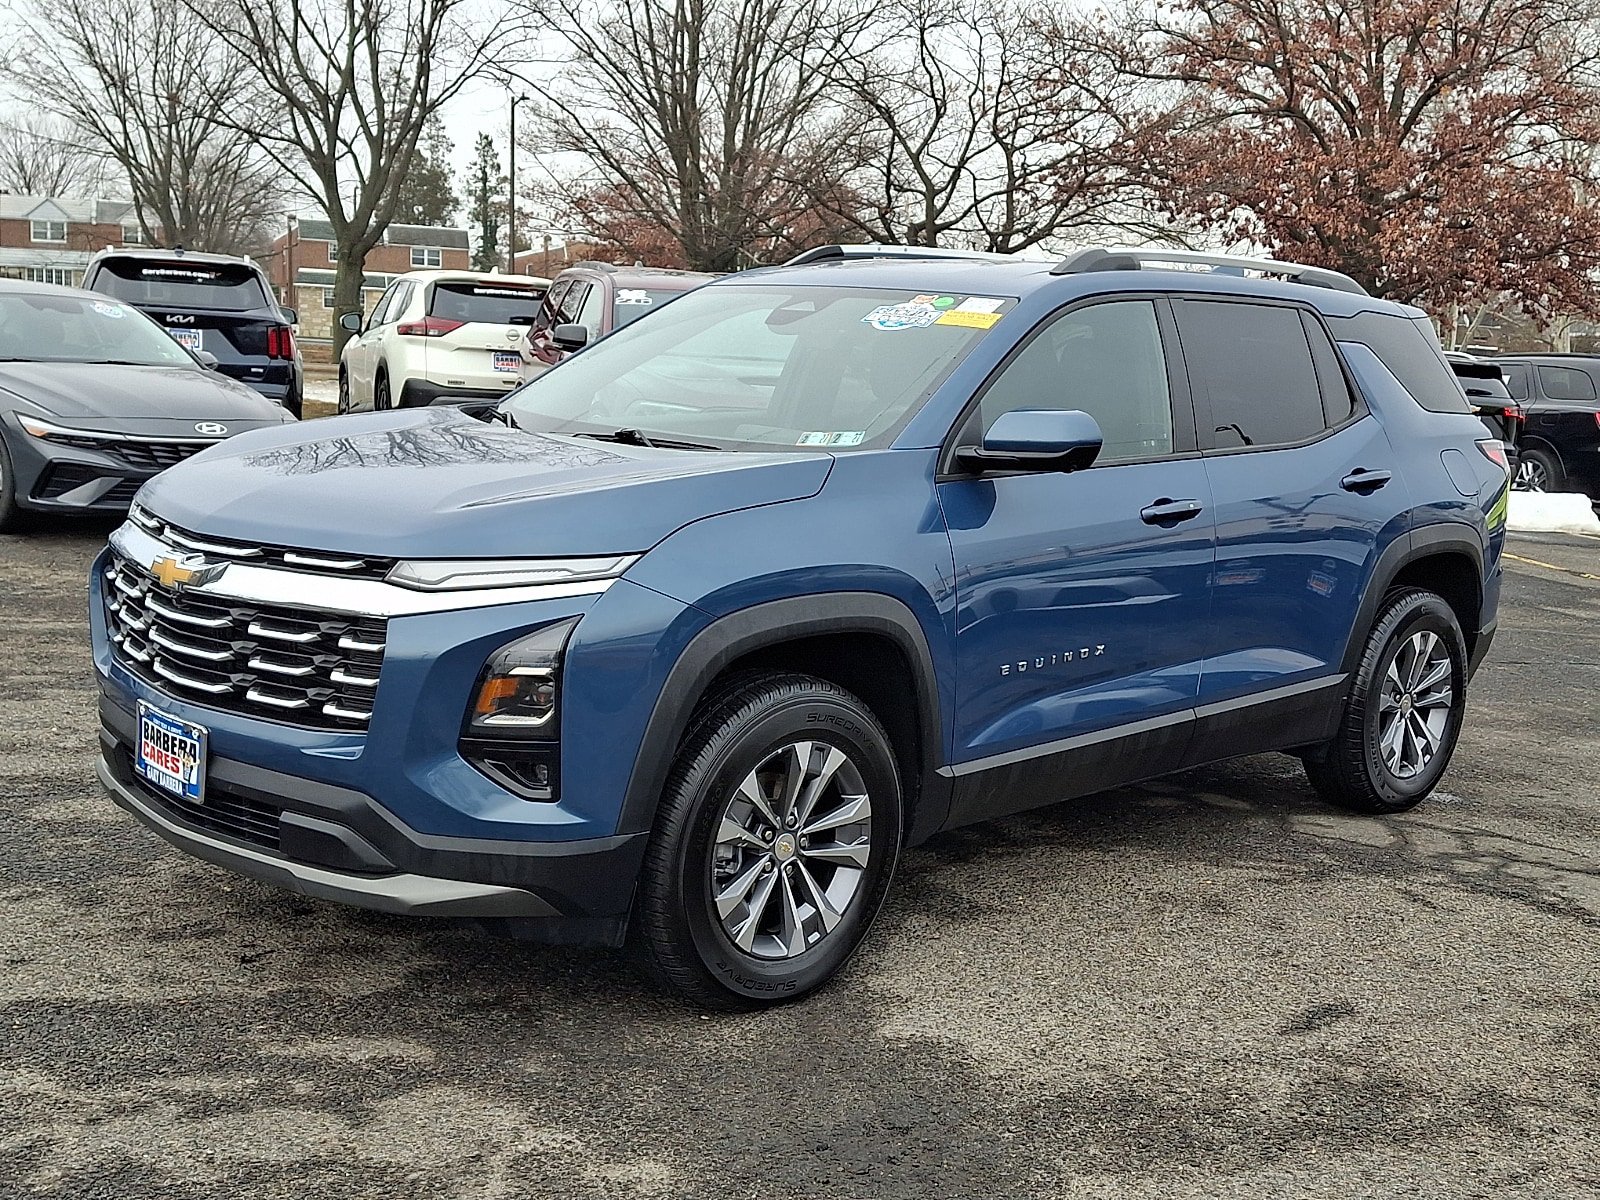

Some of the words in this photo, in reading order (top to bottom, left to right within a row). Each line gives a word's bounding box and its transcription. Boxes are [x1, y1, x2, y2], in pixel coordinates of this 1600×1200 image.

[1000, 644, 1105, 675] EQUINOX
[143, 720, 197, 763] BARBERA
[143, 740, 181, 774] CARES
[716, 960, 797, 992] SUREDRIVE
